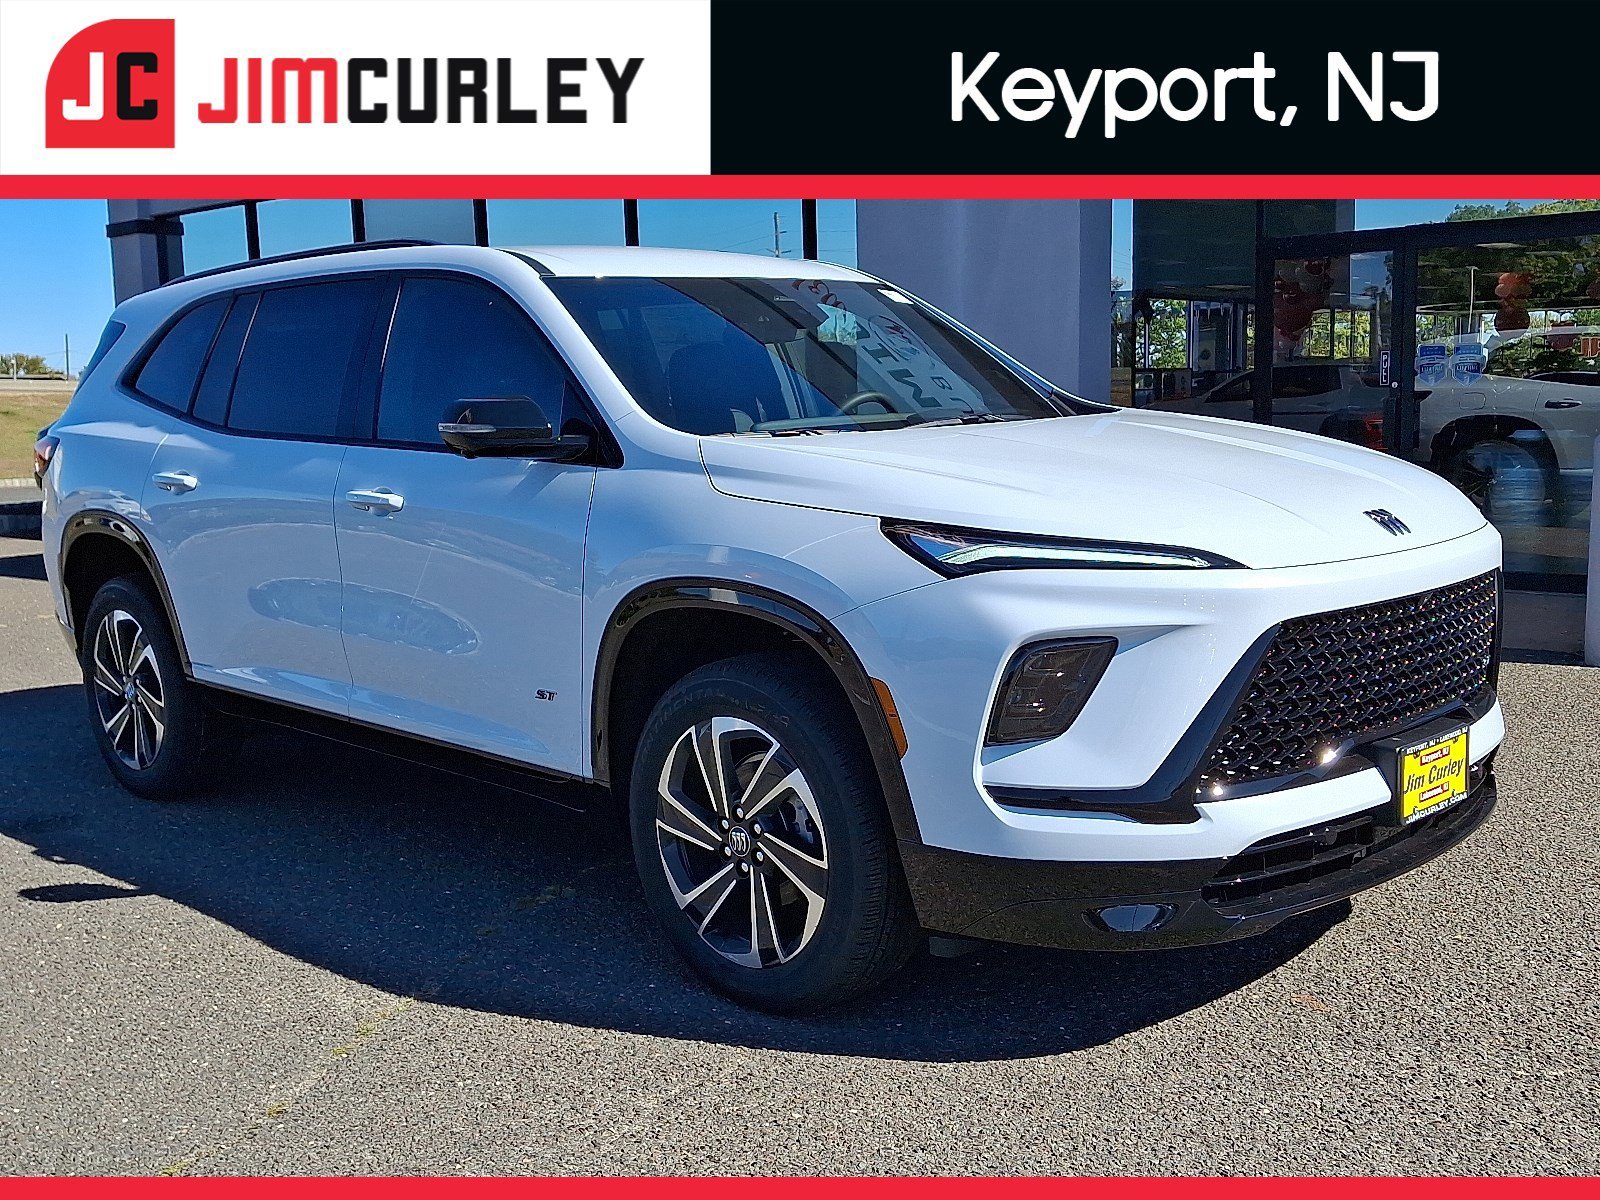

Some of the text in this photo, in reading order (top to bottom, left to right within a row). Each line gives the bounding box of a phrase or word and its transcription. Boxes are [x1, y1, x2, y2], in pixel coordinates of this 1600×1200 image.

[535, 689, 558, 701] ST
[1403, 774, 1425, 794] Jim
[1429, 759, 1464, 785] Curley
